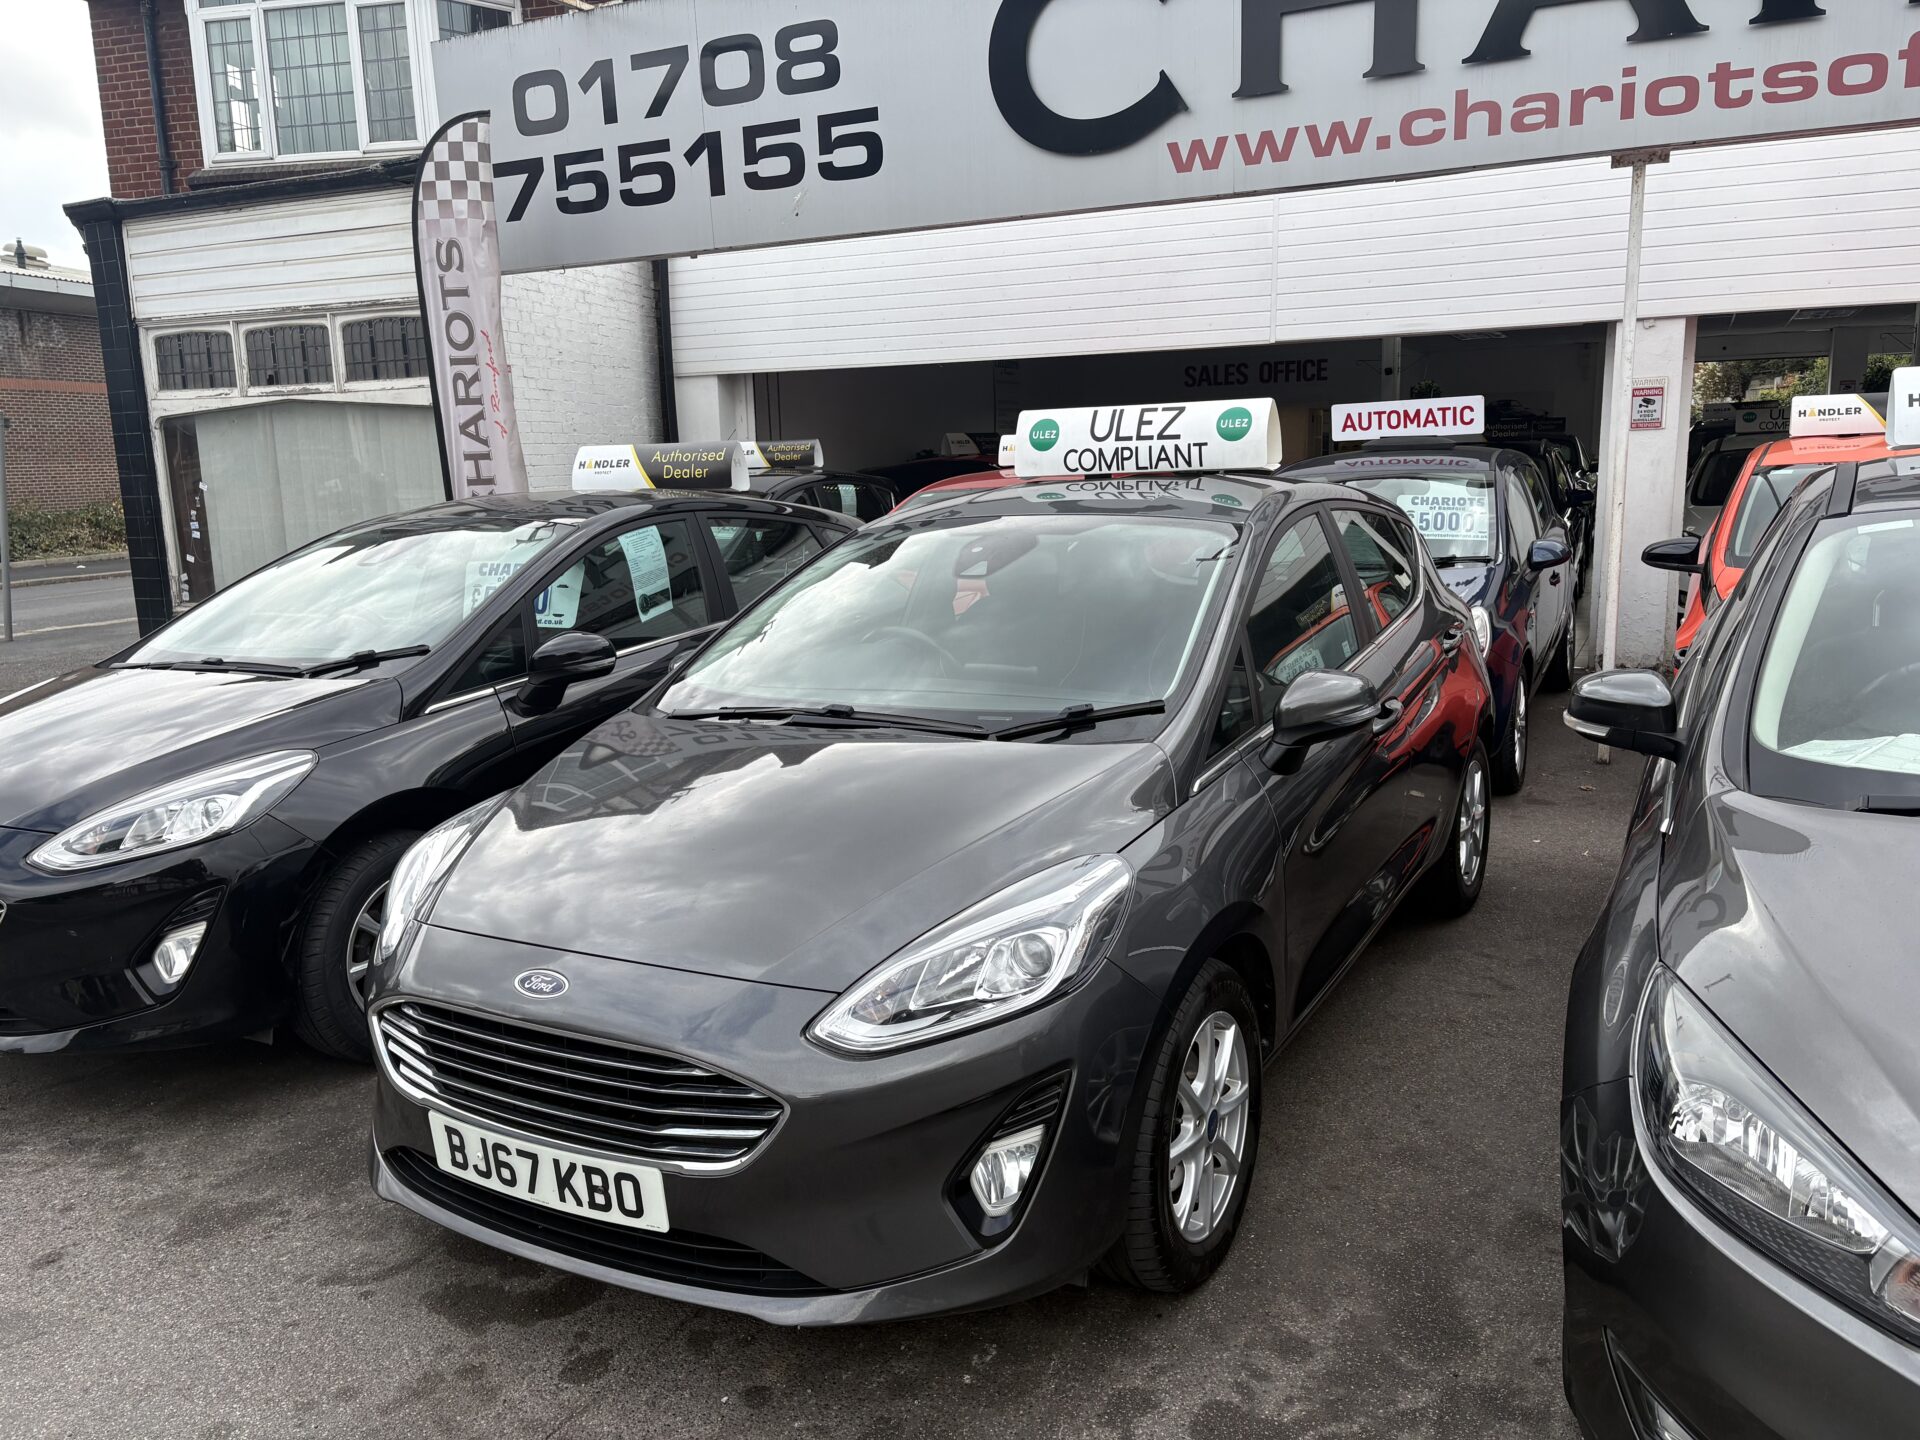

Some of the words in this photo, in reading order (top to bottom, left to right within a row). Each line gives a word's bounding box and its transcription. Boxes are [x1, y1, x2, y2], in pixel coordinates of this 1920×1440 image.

[512, 19, 841, 137] 01708
[493, 106, 884, 223] 755155
[435, 237, 498, 498] HARIOTS
[480, 329, 501, 413] Romford
[1184, 362, 1249, 388] SALES
[1258, 358, 1329, 384] OFFICE
[1633, 388, 1663, 396] WARNING
[1341, 405, 1475, 433] AUTOMATIC
[1798, 406, 1862, 418] HANDLER
[1090, 406, 1187, 442] ULEZ
[1220, 418, 1249, 429] ULEZ
[1032, 429, 1057, 440] ULEZ
[1492, 430, 1520, 438] Dealer
[766, 442, 811, 452] Authorised
[651, 448, 726, 464] Authorised
[774, 452, 802, 462] Dealer
[1063, 442, 1209, 473] COMPLIANT
[578, 459, 631, 470] HANDLER
[663, 464, 709, 479] Dealer
[1411, 496, 1486, 507] CHARIOTS
[524, 974, 554, 993] Ford
[443, 1124, 540, 1195] BJ67
[552, 1157, 645, 1220] KBO
